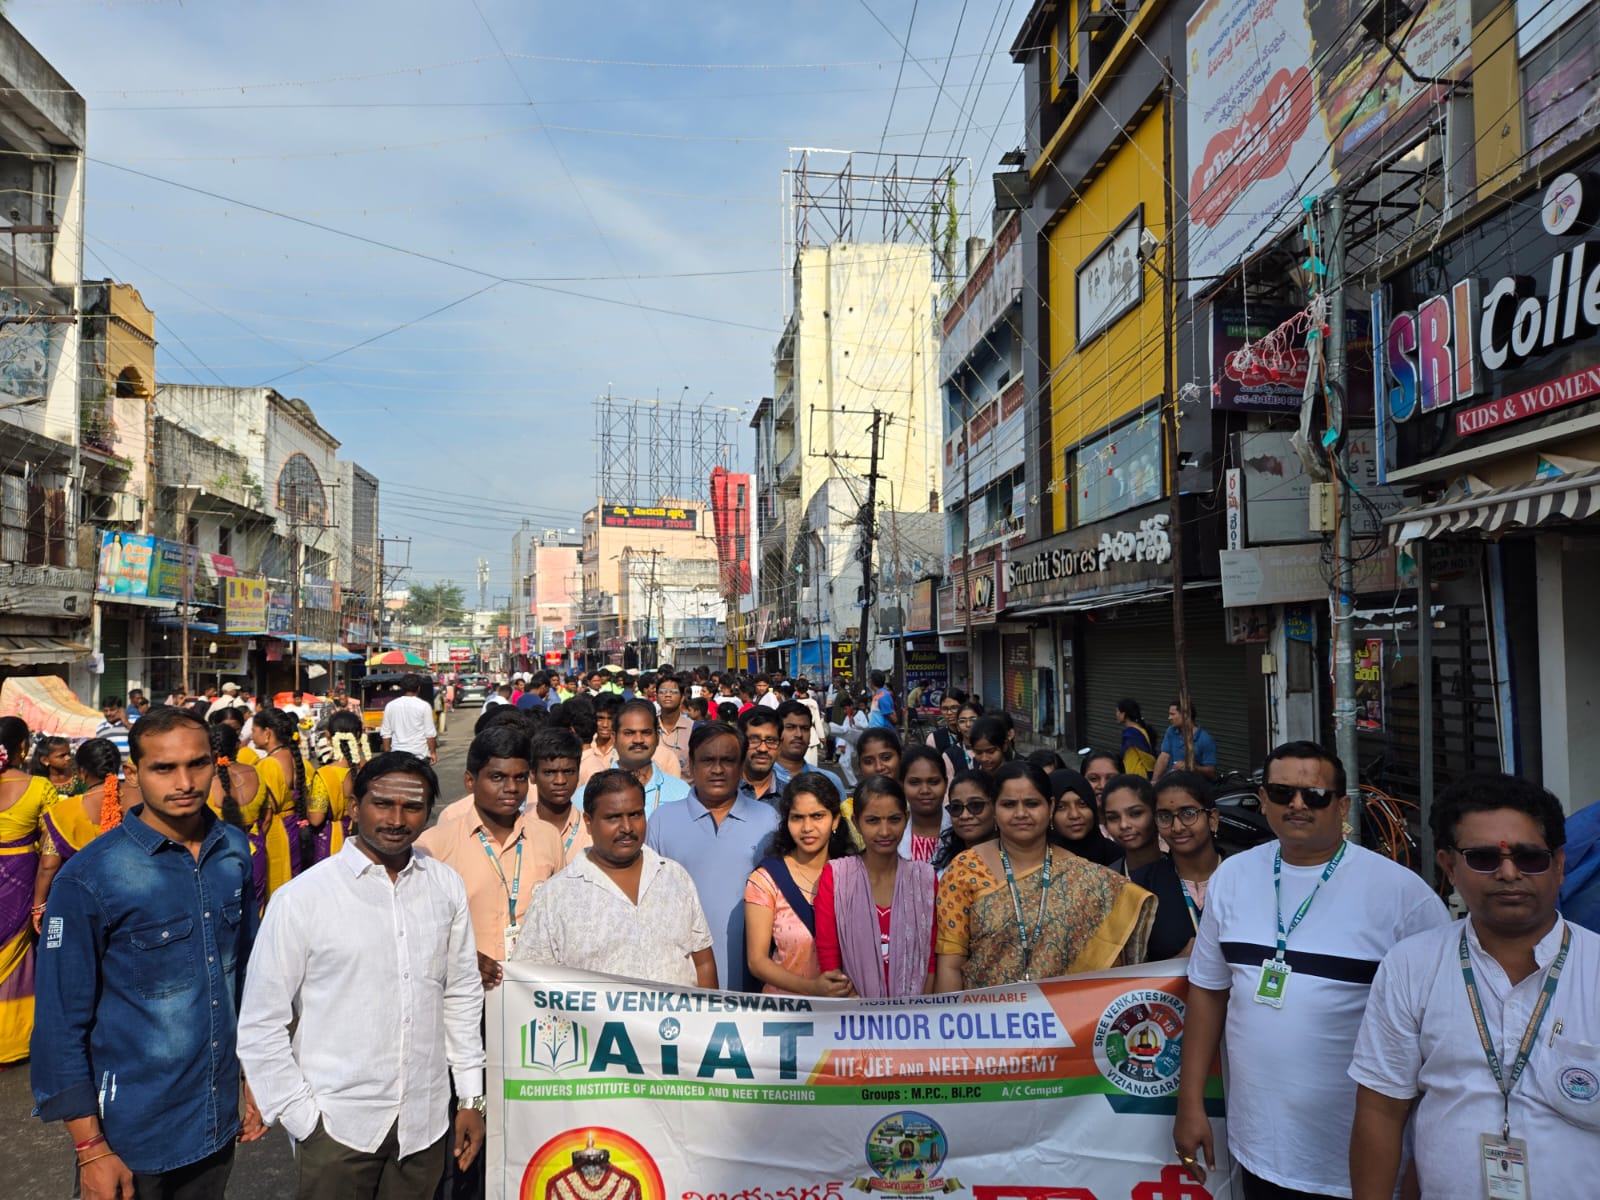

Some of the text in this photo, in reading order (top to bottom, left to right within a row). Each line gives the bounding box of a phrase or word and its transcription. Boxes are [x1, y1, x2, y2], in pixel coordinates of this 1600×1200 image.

[1387, 278, 1474, 423] SRI
[1458, 404, 1499, 433] KIDS
[1503, 399, 1517, 420] &
[606, 517, 624, 525] NEW
[627, 518, 663, 528] MODERN
[1008, 548, 1096, 587] Sarathi Stores
[533, 990, 813, 1013] SREE VENKATESWARA
[963, 992, 1028, 1004] AVAILABLE
[834, 1012, 1058, 1041] JUNIOR COLLEGE
[1094, 991, 1185, 1047] SREE VENKATESWARA
[834, 1054, 1058, 1078] IIT-JEE AND NEET ACADEMY
[1127, 1063, 1138, 1075] 12
[1143, 1067, 1154, 1077] 22
[520, 1082, 816, 1102] ACHIVERS INSTITUTE OF ADVANCED AND NEET TEACHING
[1002, 1084, 1063, 1099] A/C Campus
[1107, 1069, 1181, 1096] VIZIANAGARA
[861, 1088, 900, 1102] Groups
